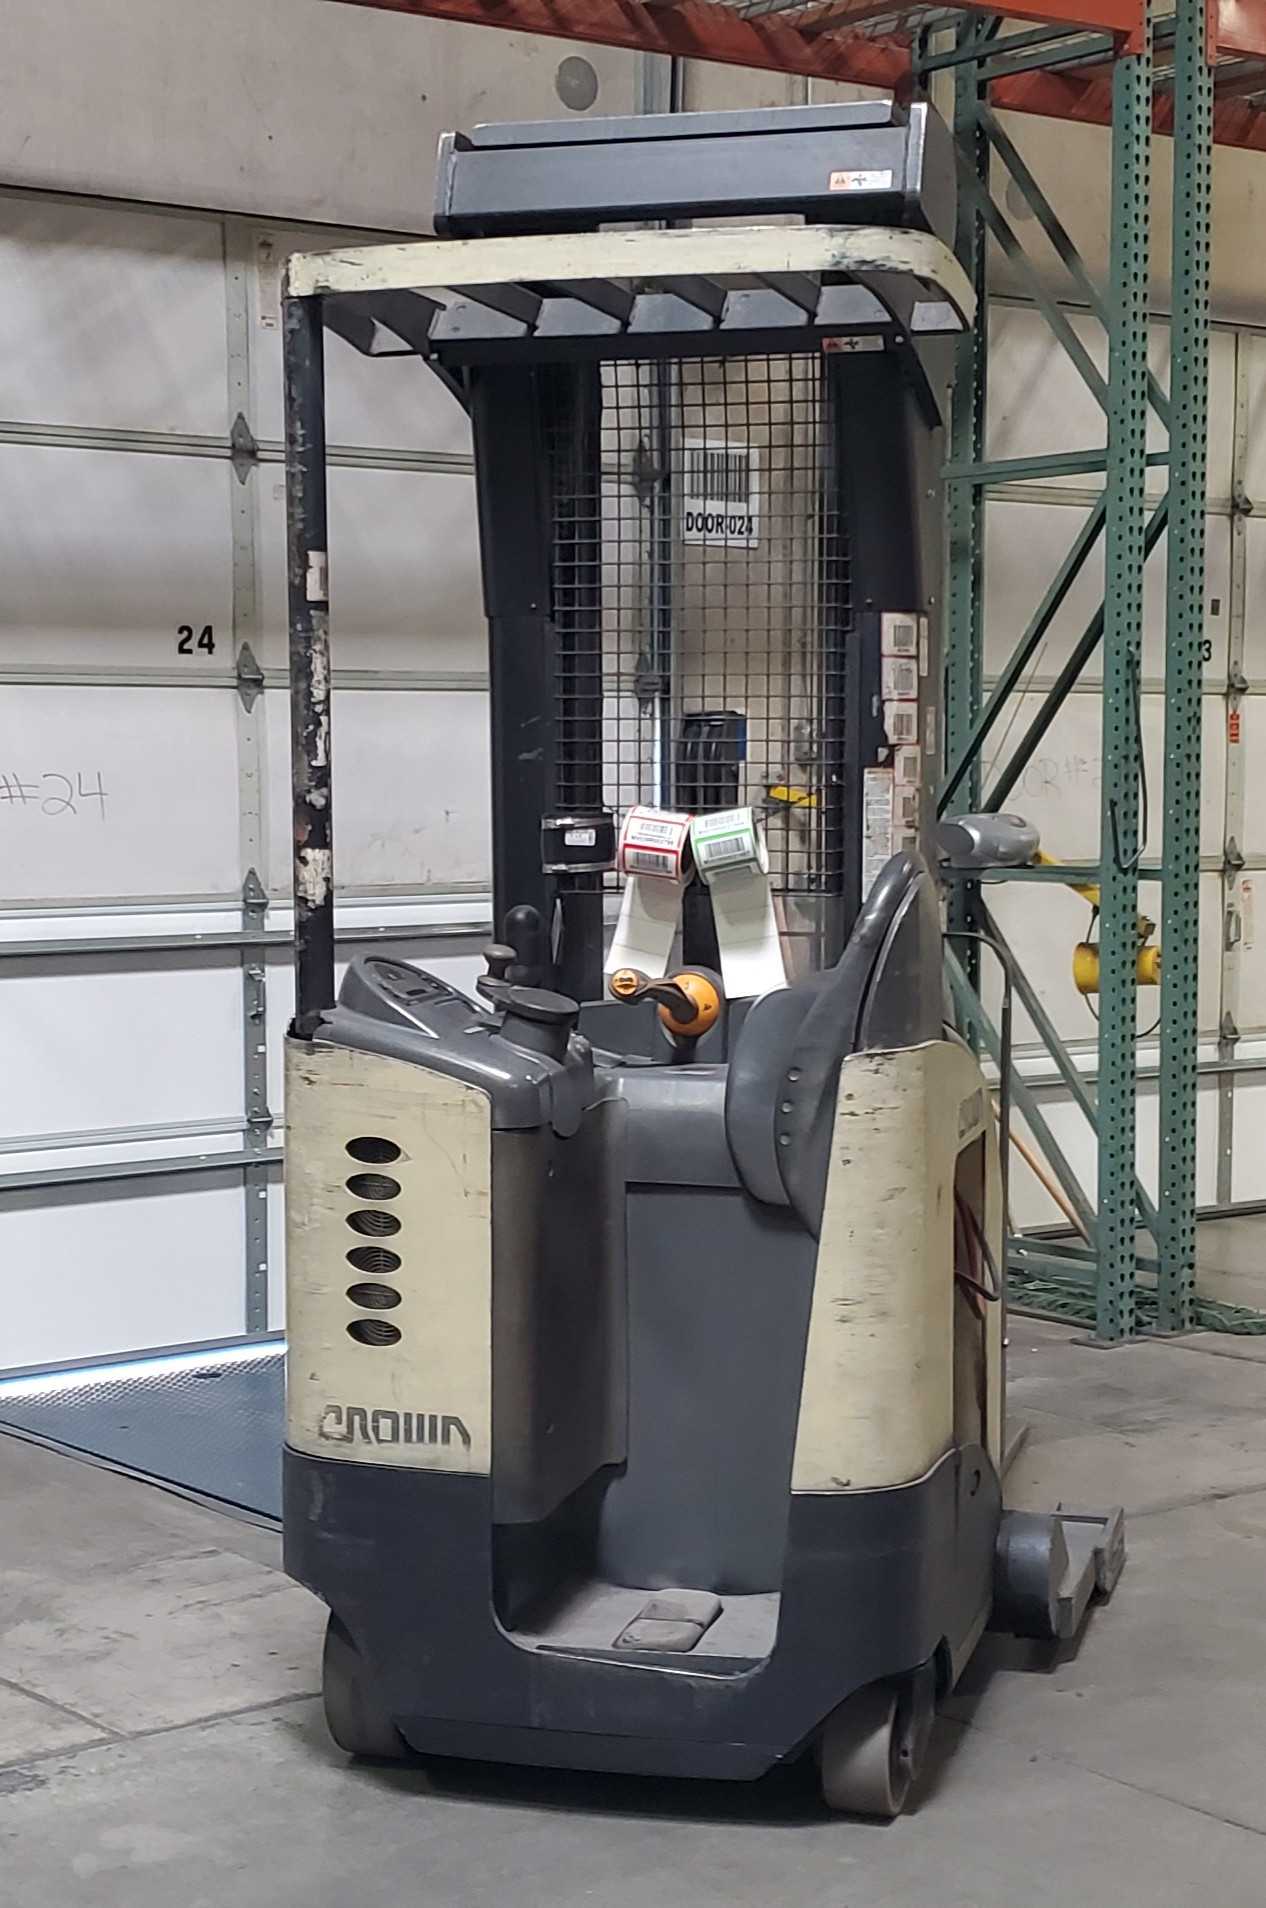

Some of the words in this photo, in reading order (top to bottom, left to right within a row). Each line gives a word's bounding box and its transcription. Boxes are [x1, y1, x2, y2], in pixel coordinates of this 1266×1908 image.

[177, 625, 215, 655] 24
[0, 771, 109, 821] #24
[318, 1404, 472, 1452] CROWN
